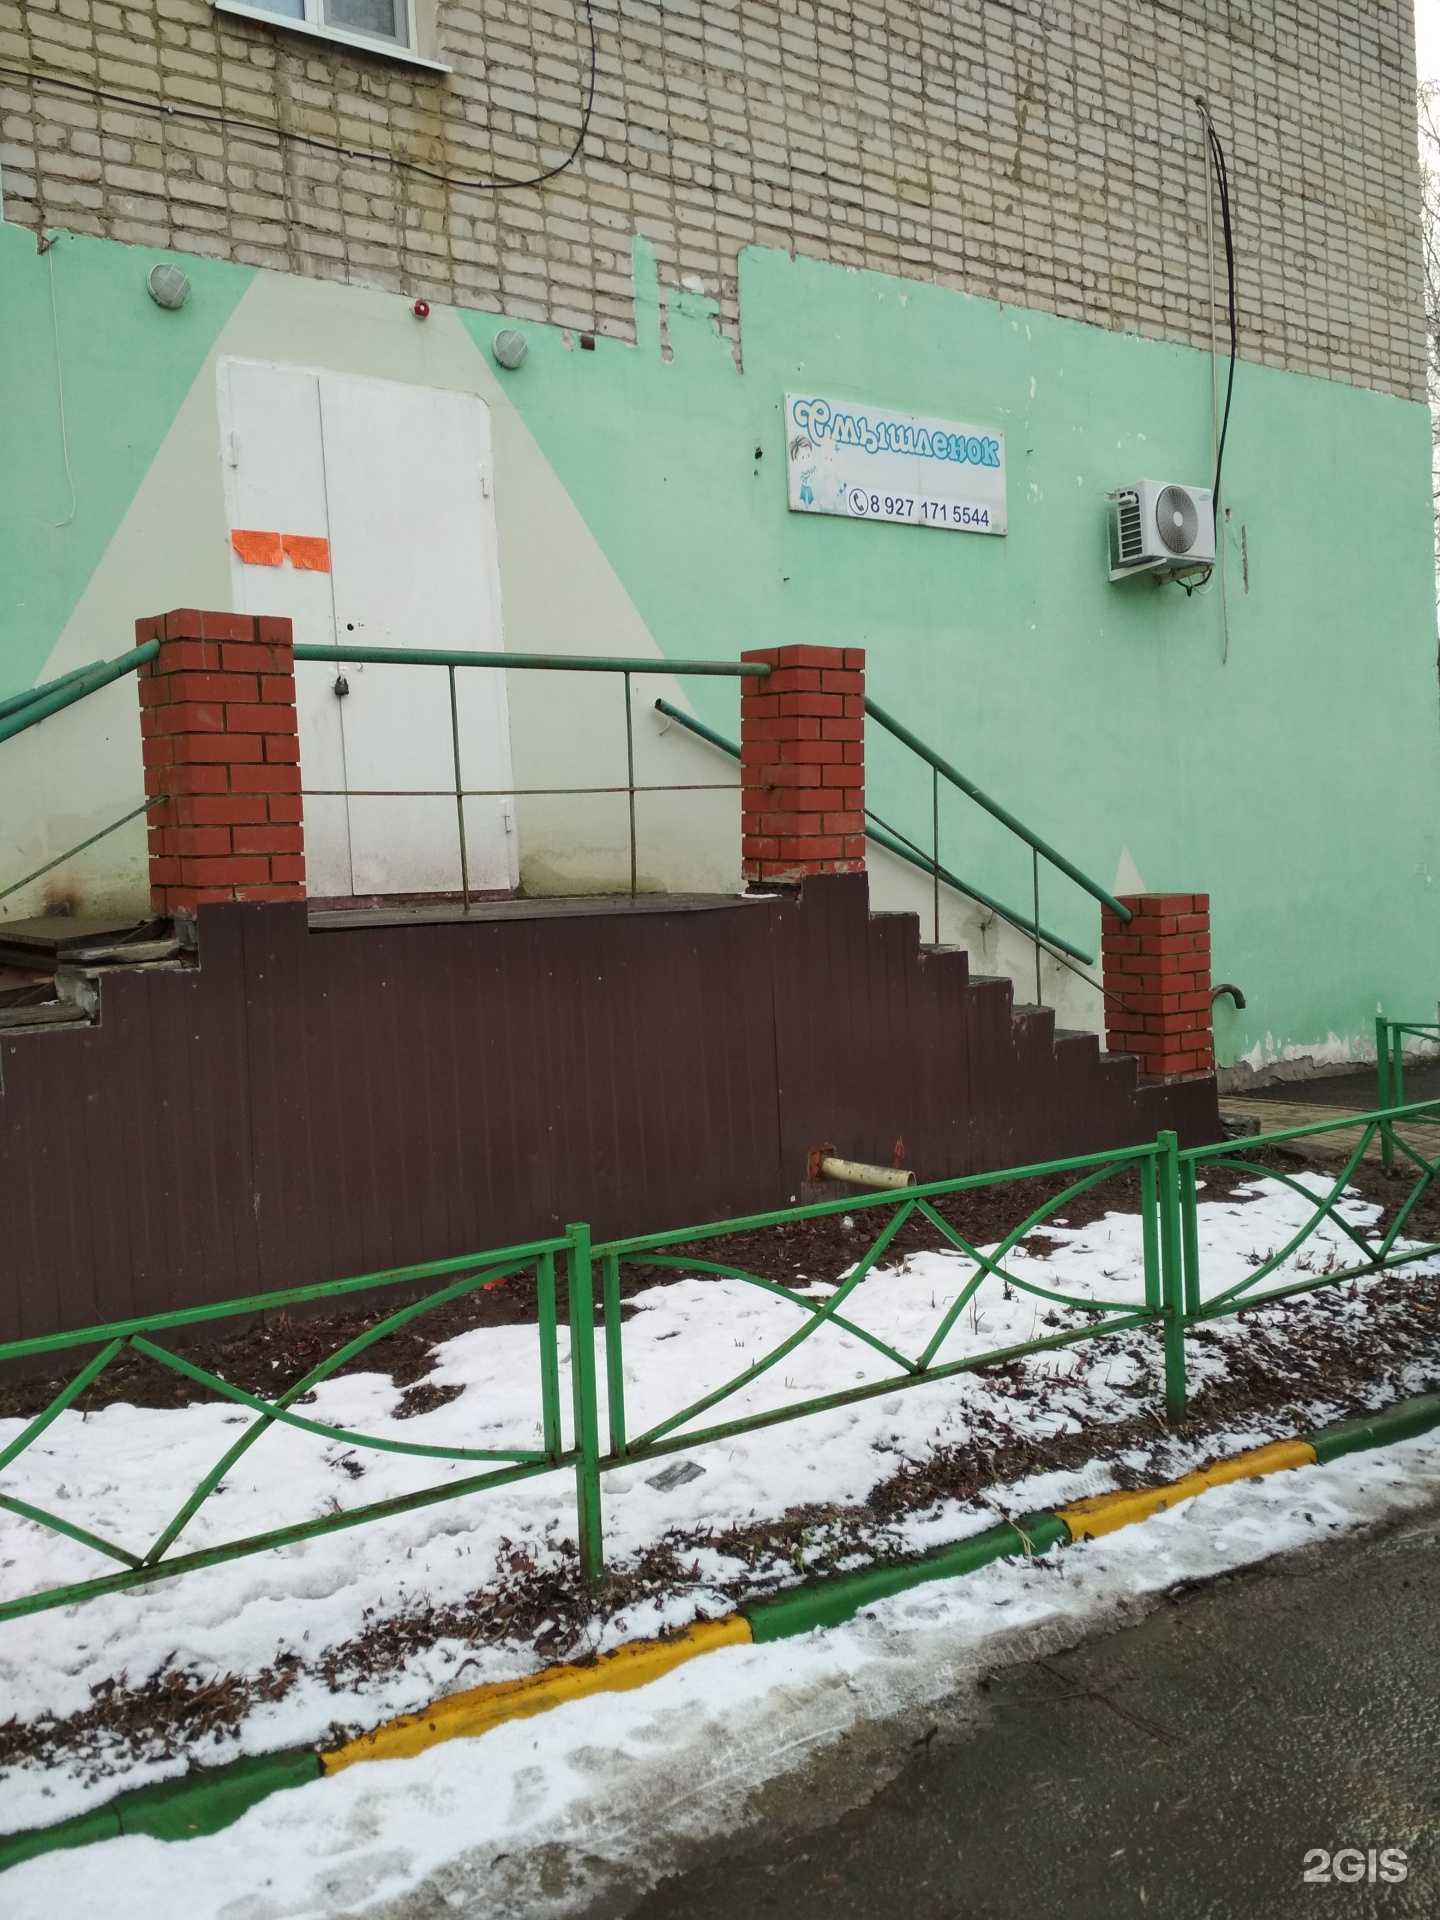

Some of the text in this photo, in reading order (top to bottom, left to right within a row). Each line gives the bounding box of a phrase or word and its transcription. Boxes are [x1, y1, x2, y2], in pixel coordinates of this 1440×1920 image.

[870, 495, 989, 526] 8 927 171 5544
